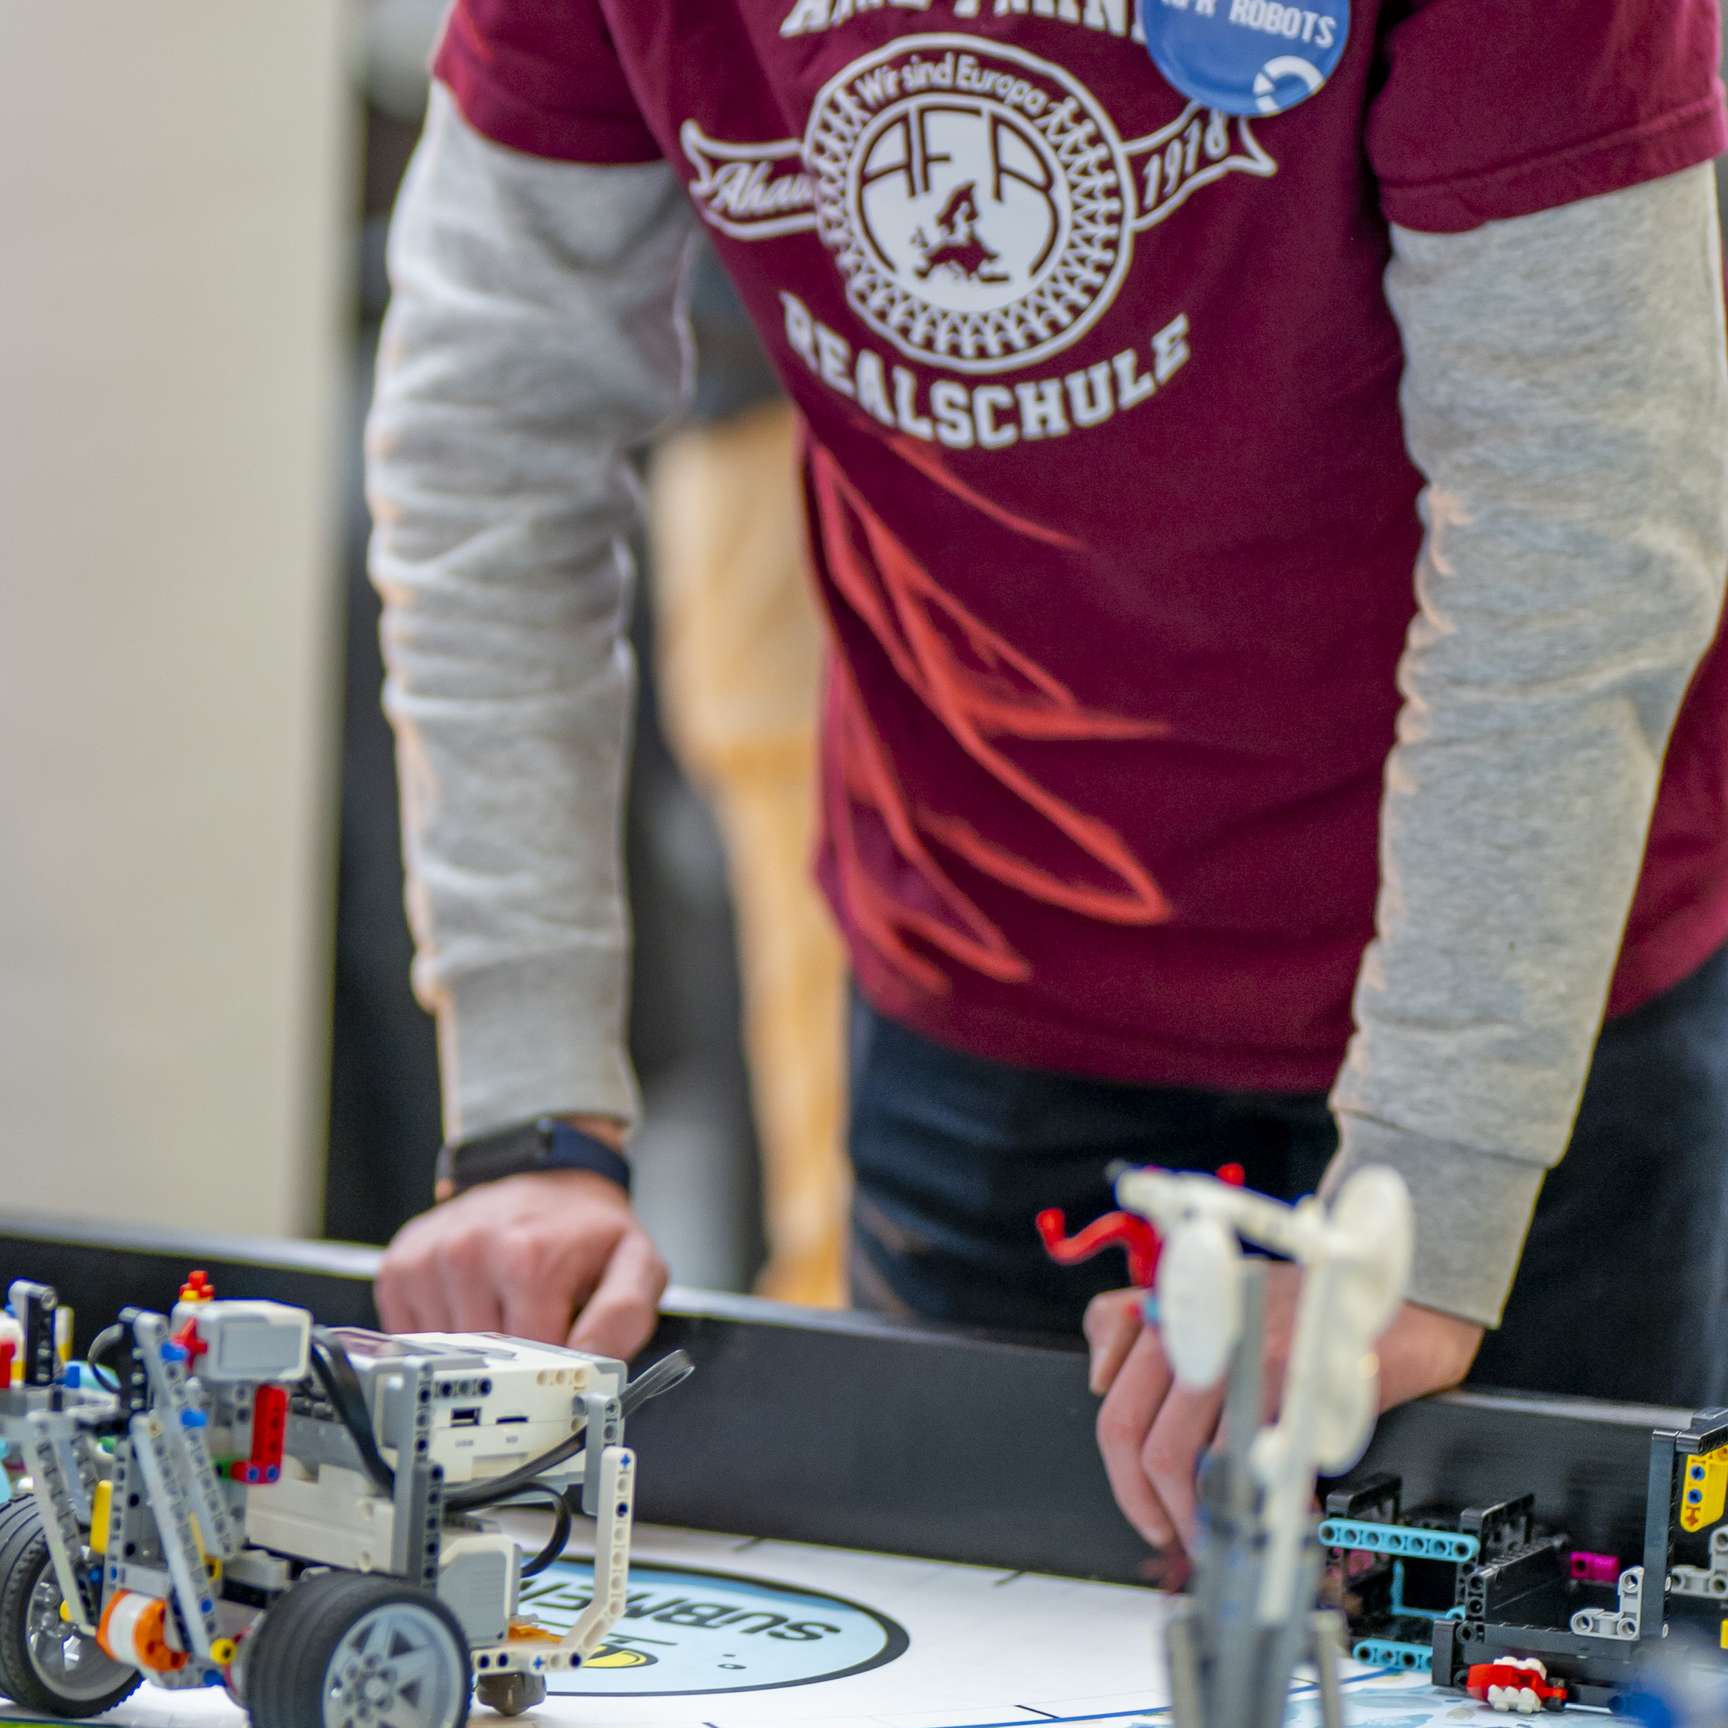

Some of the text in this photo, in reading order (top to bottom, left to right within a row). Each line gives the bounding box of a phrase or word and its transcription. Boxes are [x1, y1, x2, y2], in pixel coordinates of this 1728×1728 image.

[855, 51, 1046, 115] Wir sind Europa
[778, 290, 1191, 450] REALSCHULE
